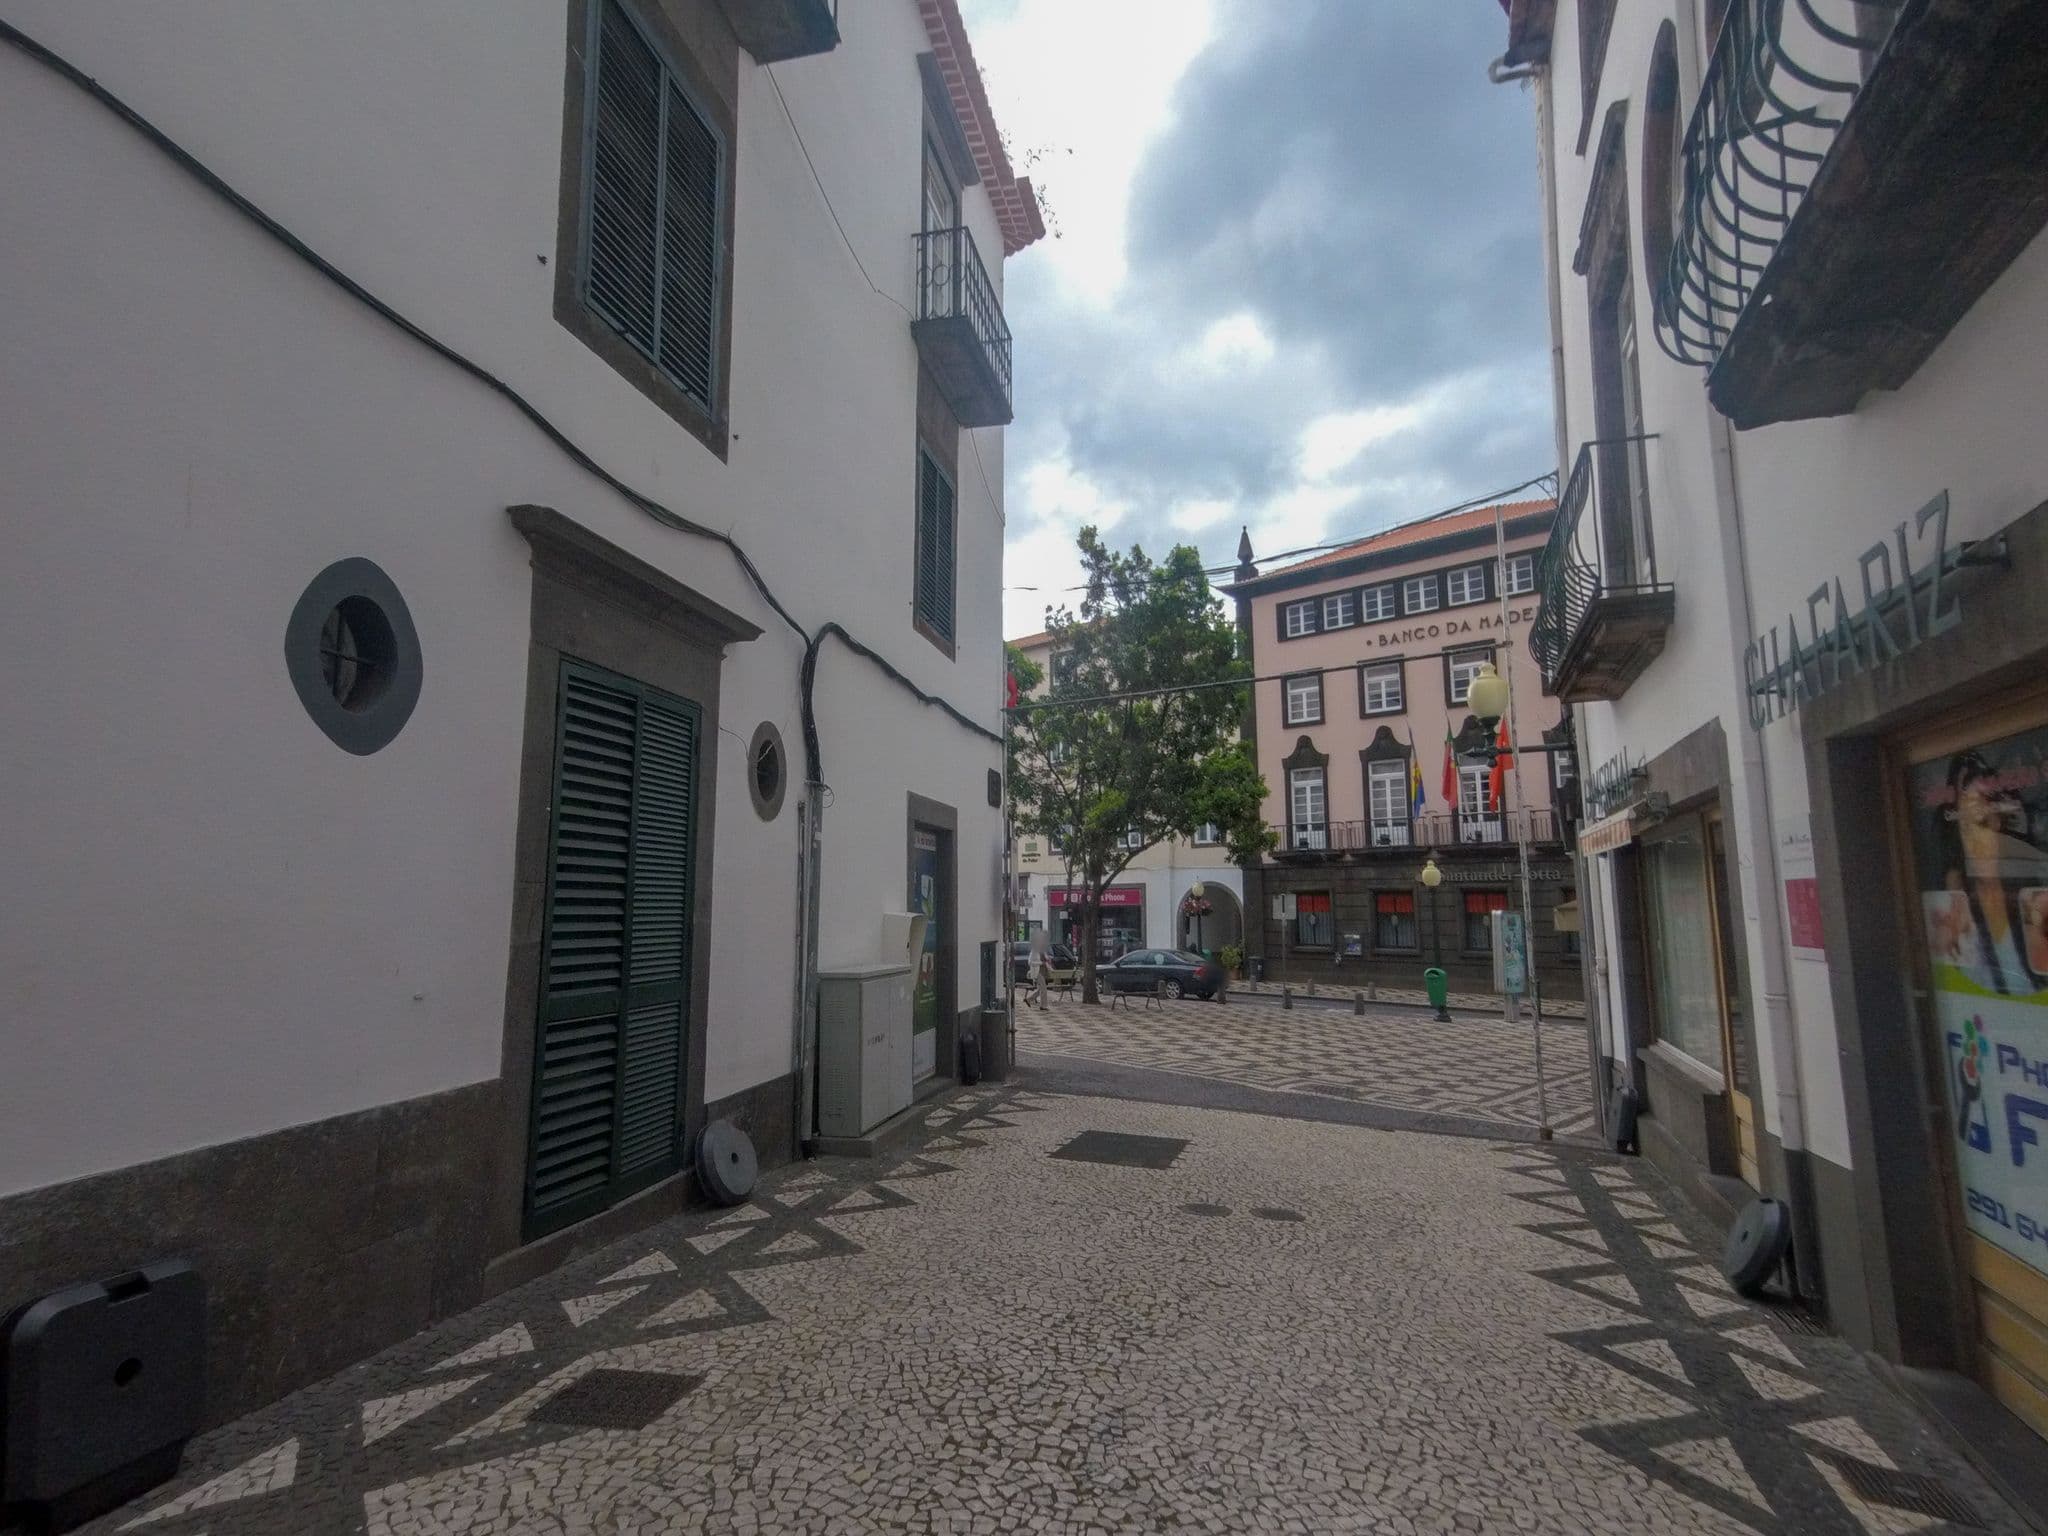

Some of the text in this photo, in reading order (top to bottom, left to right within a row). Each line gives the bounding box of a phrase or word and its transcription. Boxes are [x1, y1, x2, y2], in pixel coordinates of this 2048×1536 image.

[1378, 607, 1534, 647] BANCO DA MADE
[1743, 488, 1963, 732] CHAFARIZ
[1520, 868, 1561, 881] otta
[1967, 1188, 2012, 1229] 291
